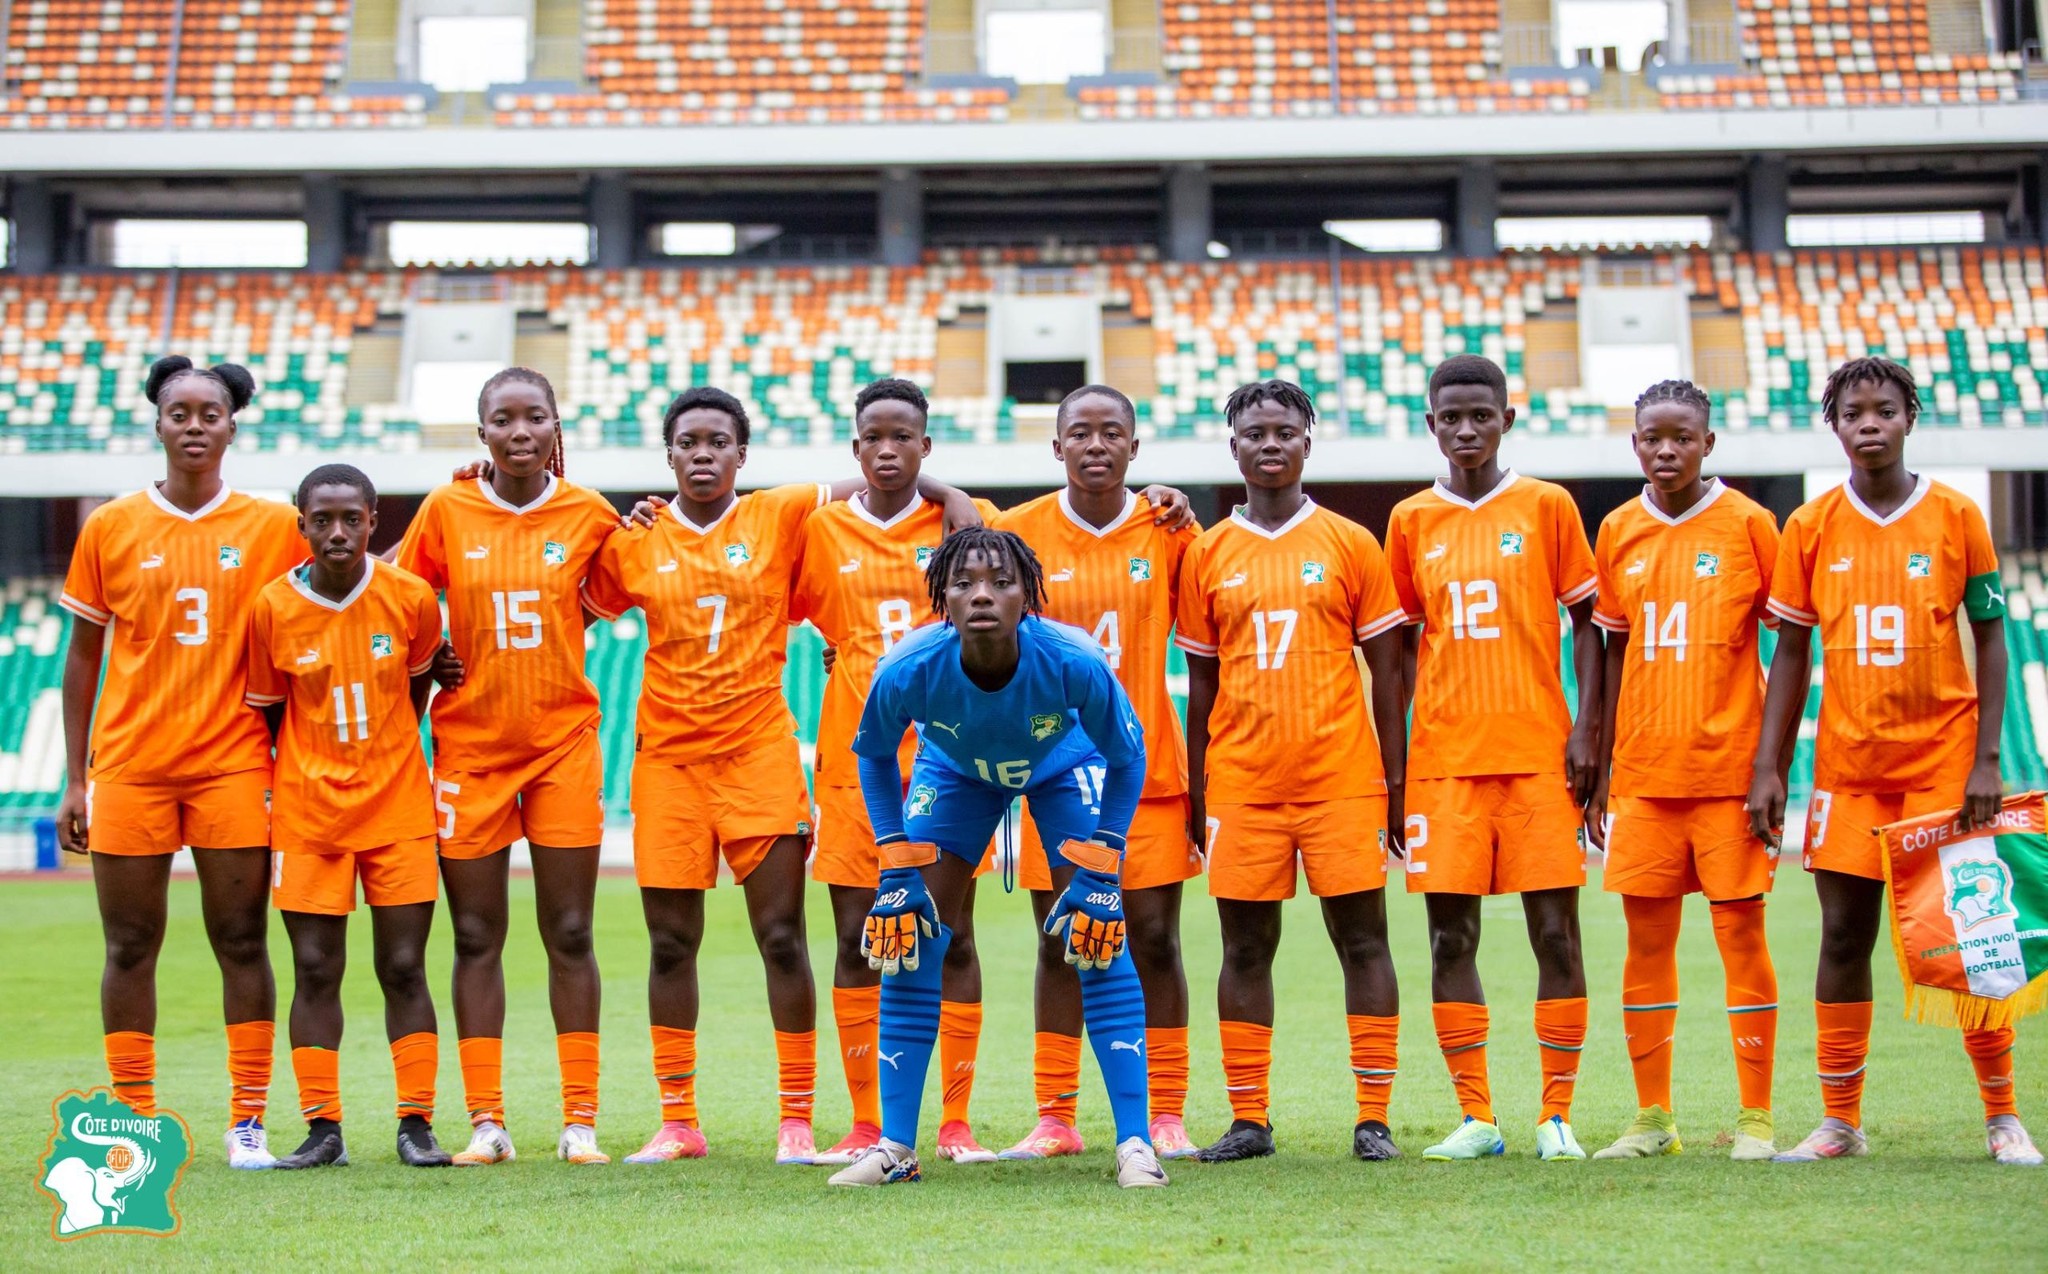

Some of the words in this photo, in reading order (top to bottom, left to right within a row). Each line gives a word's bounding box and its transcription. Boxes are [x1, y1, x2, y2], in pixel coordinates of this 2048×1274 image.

[176, 588, 208, 646] 3
[491, 590, 543, 650] 15
[697, 595, 727, 654] 7
[878, 599, 913, 655] 8
[1447, 580, 1500, 640] 12
[1643, 602, 1687, 662] 14
[1854, 605, 1904, 666] 19
[1091, 610, 1122, 669] 4
[1252, 609, 1298, 670] 17
[333, 682, 368, 742] 11
[974, 758, 1032, 789] 16
[1902, 825, 1949, 852] CÔTE
[1921, 938, 1990, 960] FEDERATION
[1966, 957, 2022, 976] FOOTBALL
[1984, 948, 1999, 959] DE
[847, 1043, 871, 1059] FIF
[1737, 1036, 1763, 1048] FIF
